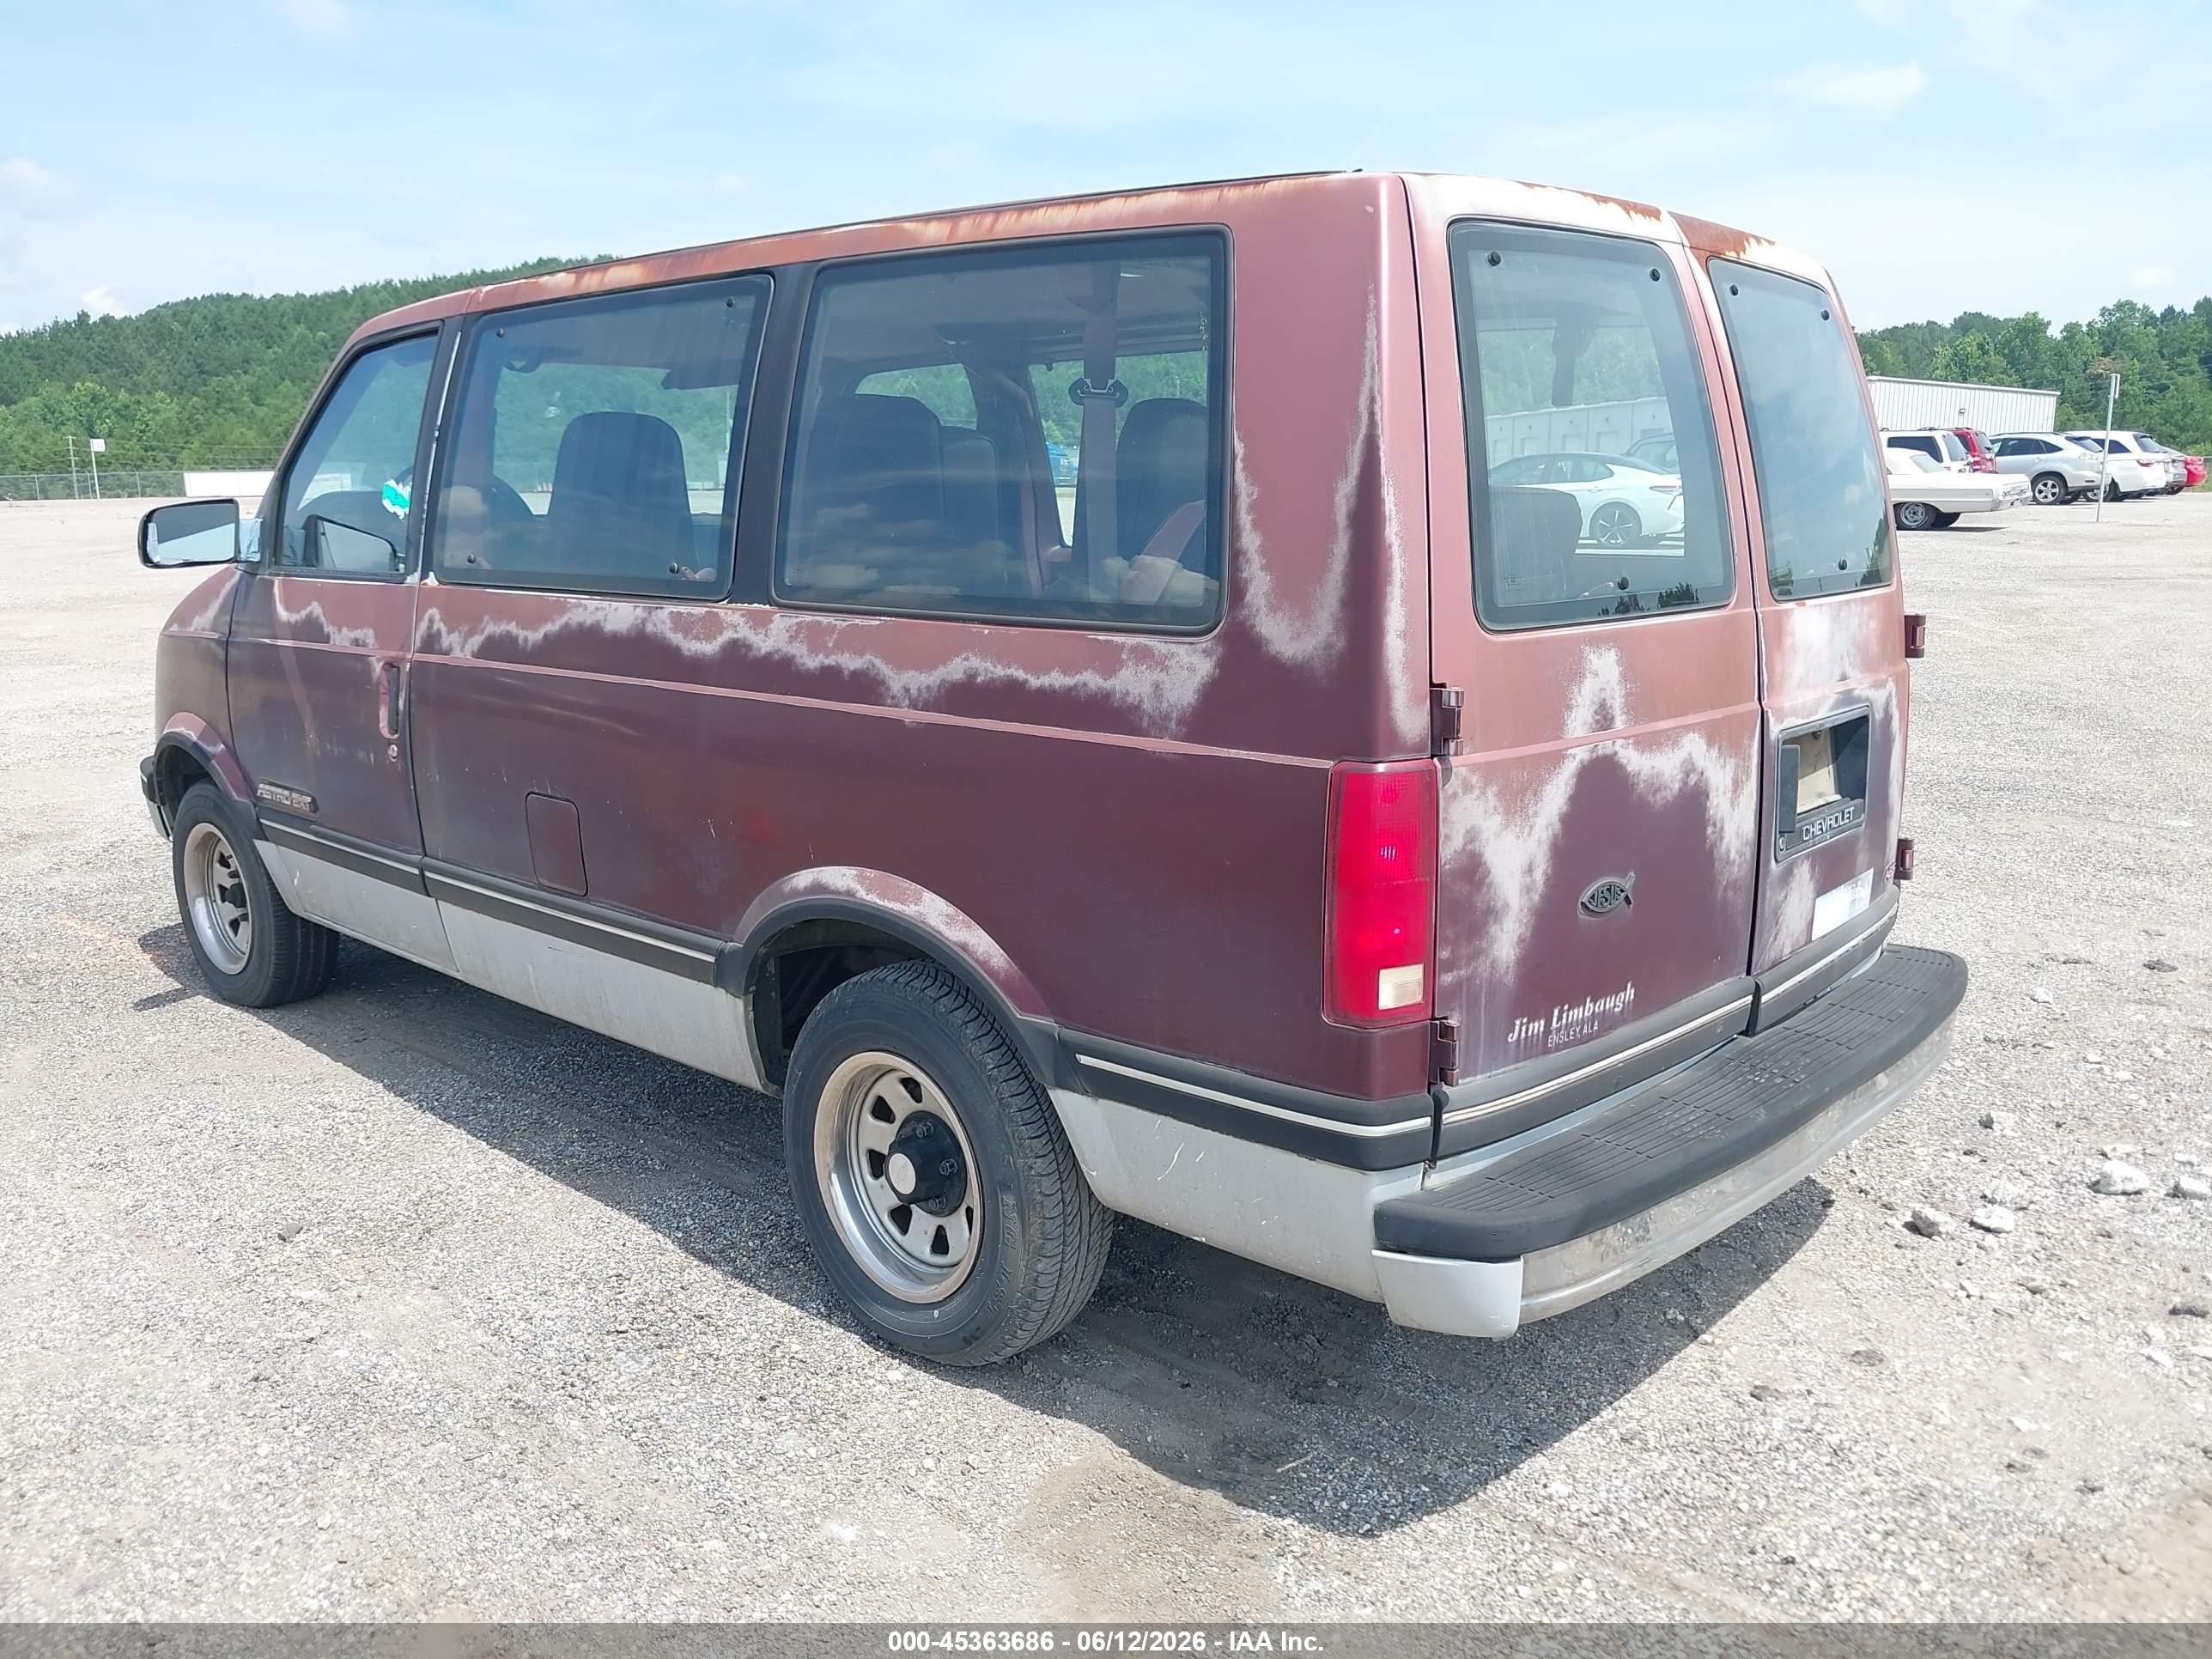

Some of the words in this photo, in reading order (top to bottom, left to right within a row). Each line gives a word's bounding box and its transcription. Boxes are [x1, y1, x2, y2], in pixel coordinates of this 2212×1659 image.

[1801, 806, 1855, 841] CHEVROLET
[1588, 884, 1622, 908] JESUS
[1507, 1017, 1546, 1042] Jim
[1550, 981, 1635, 1030] Limbaugh
[1583, 1019, 1599, 1036] ALA
